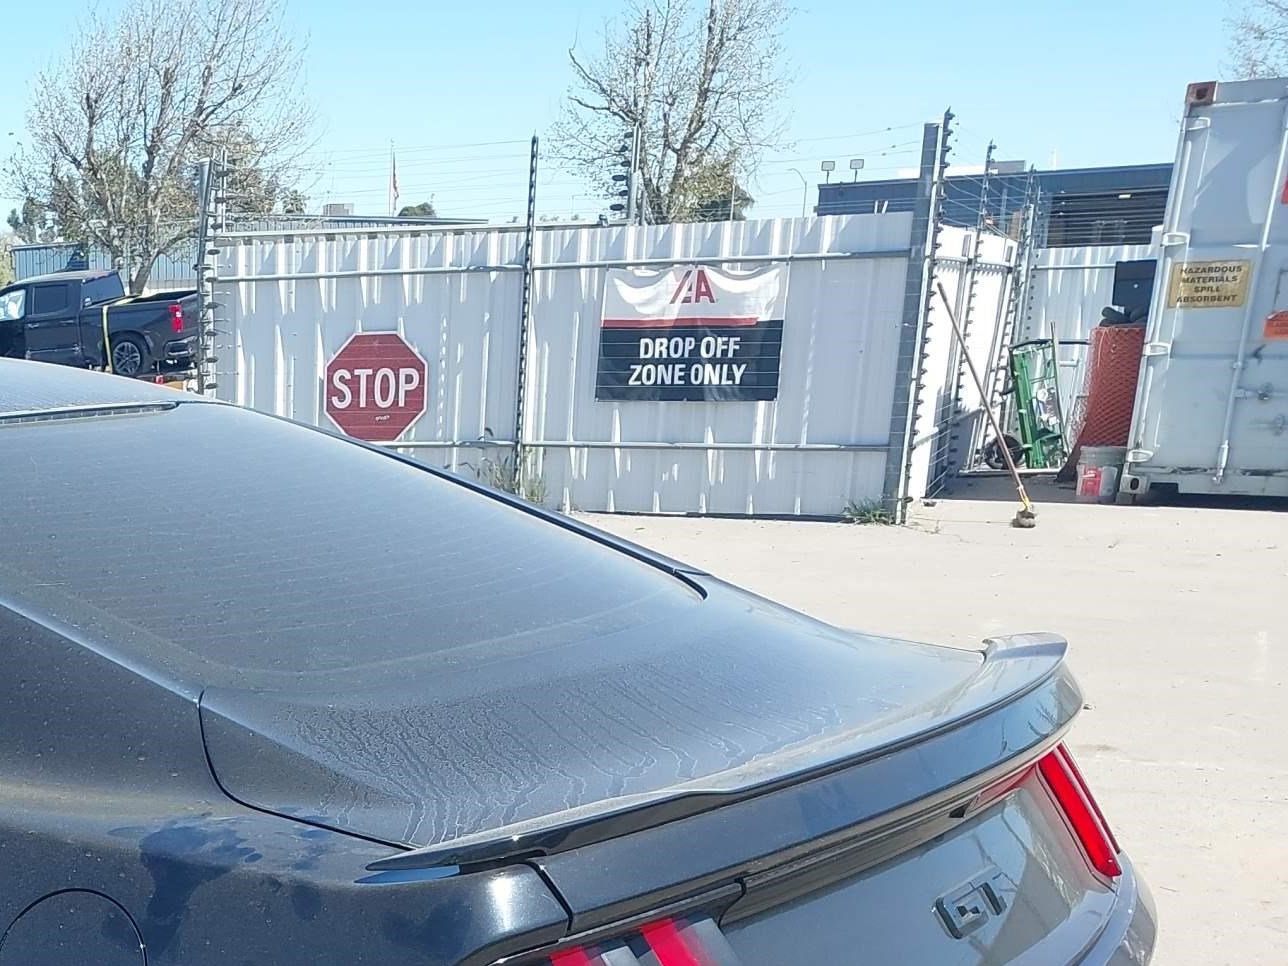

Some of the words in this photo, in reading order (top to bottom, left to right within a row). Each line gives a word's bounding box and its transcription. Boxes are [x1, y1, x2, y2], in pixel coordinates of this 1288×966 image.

[1180, 265, 1242, 275] HAZARDOUS
[1181, 275, 1239, 284] MATERIALS
[1176, 295, 1238, 303] ABSORBENT
[640, 337, 696, 359] DROP
[700, 336, 741, 359] OFF
[628, 364, 686, 386] ZONE
[690, 363, 748, 385] ONLY
[331, 367, 420, 409] STOP
